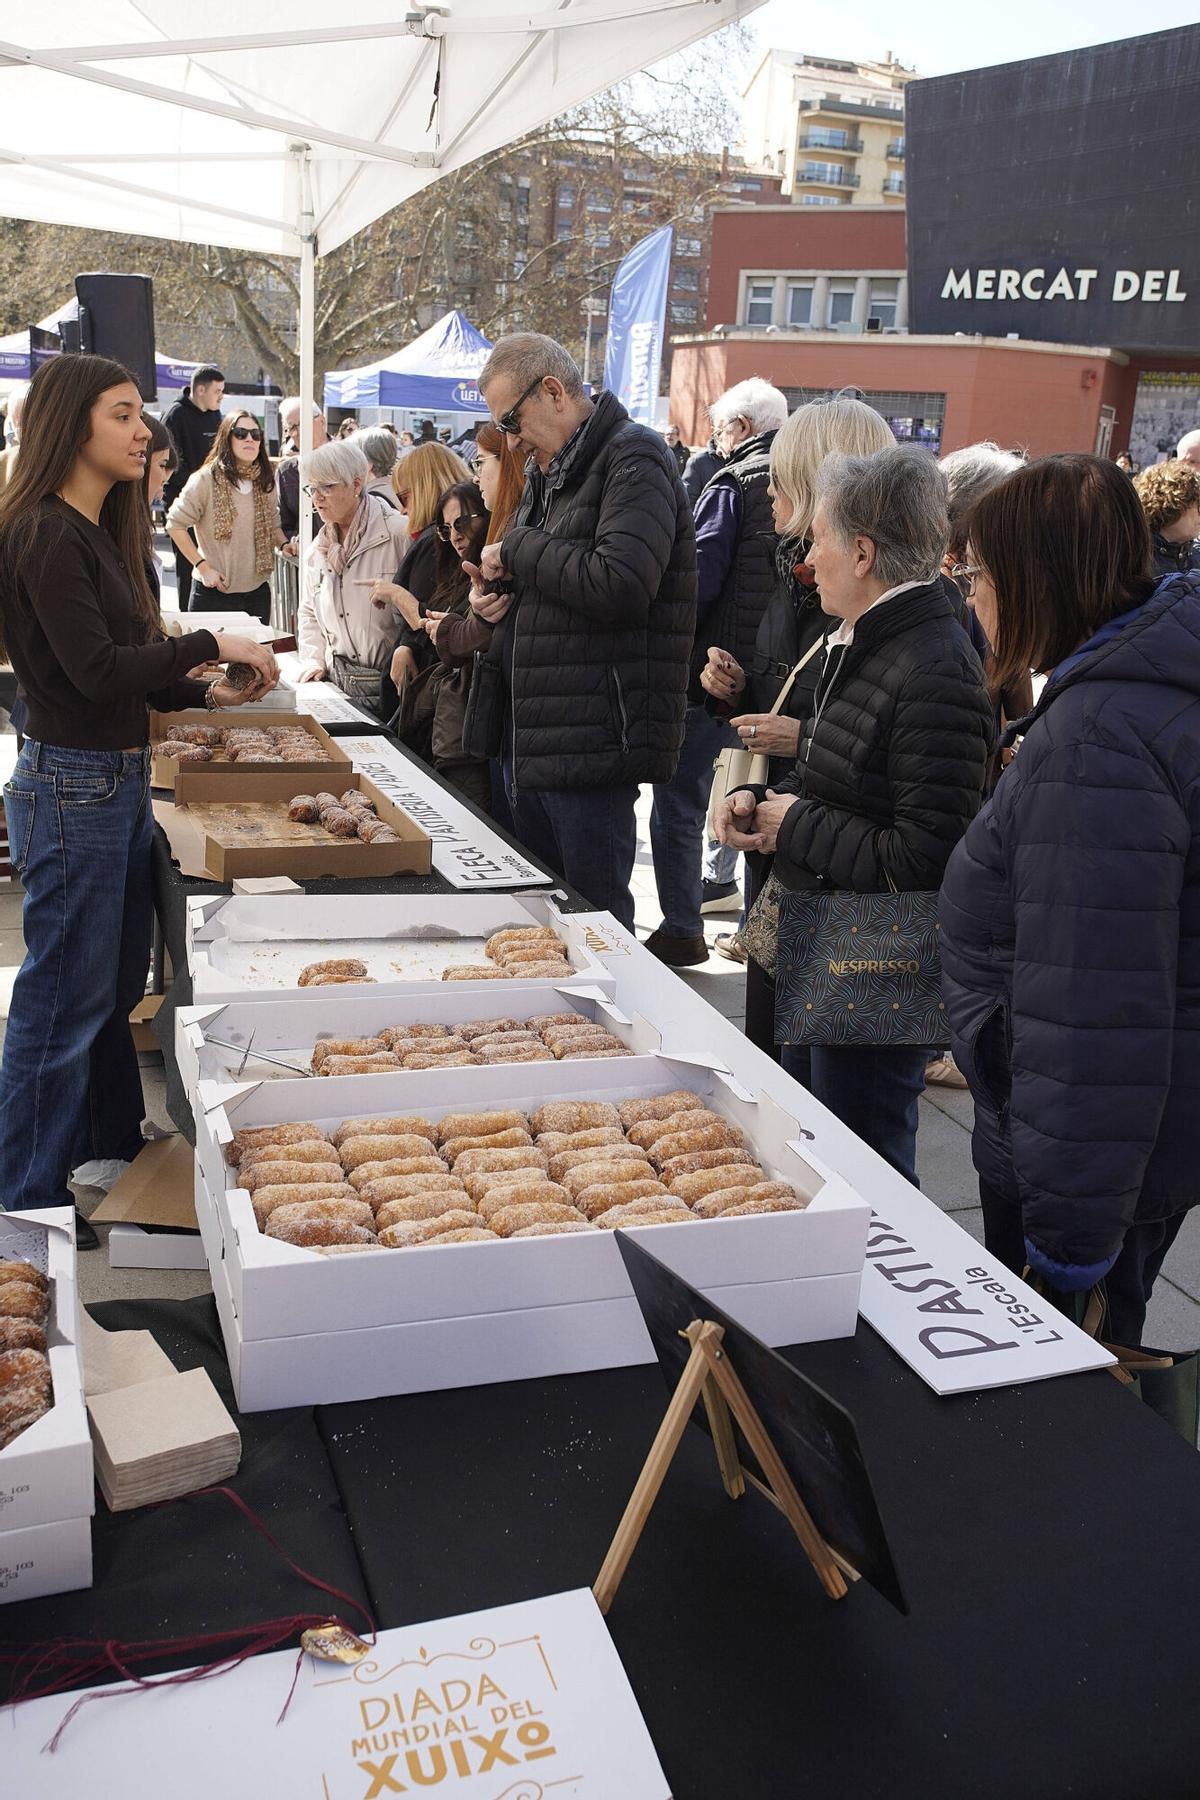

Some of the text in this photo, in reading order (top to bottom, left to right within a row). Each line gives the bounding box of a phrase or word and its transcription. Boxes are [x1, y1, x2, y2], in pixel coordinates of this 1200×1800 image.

[941, 267, 1187, 301] MERCAT DEL
[450, 846, 513, 881] FLECA
[501, 855, 537, 878] Banyoles
[827, 959, 920, 976] NESPRESSO
[965, 1266, 1064, 1344] L'Escala
[359, 1673, 508, 1731] DIADA
[352, 1699, 543, 1757] MUNDIAL DEL
